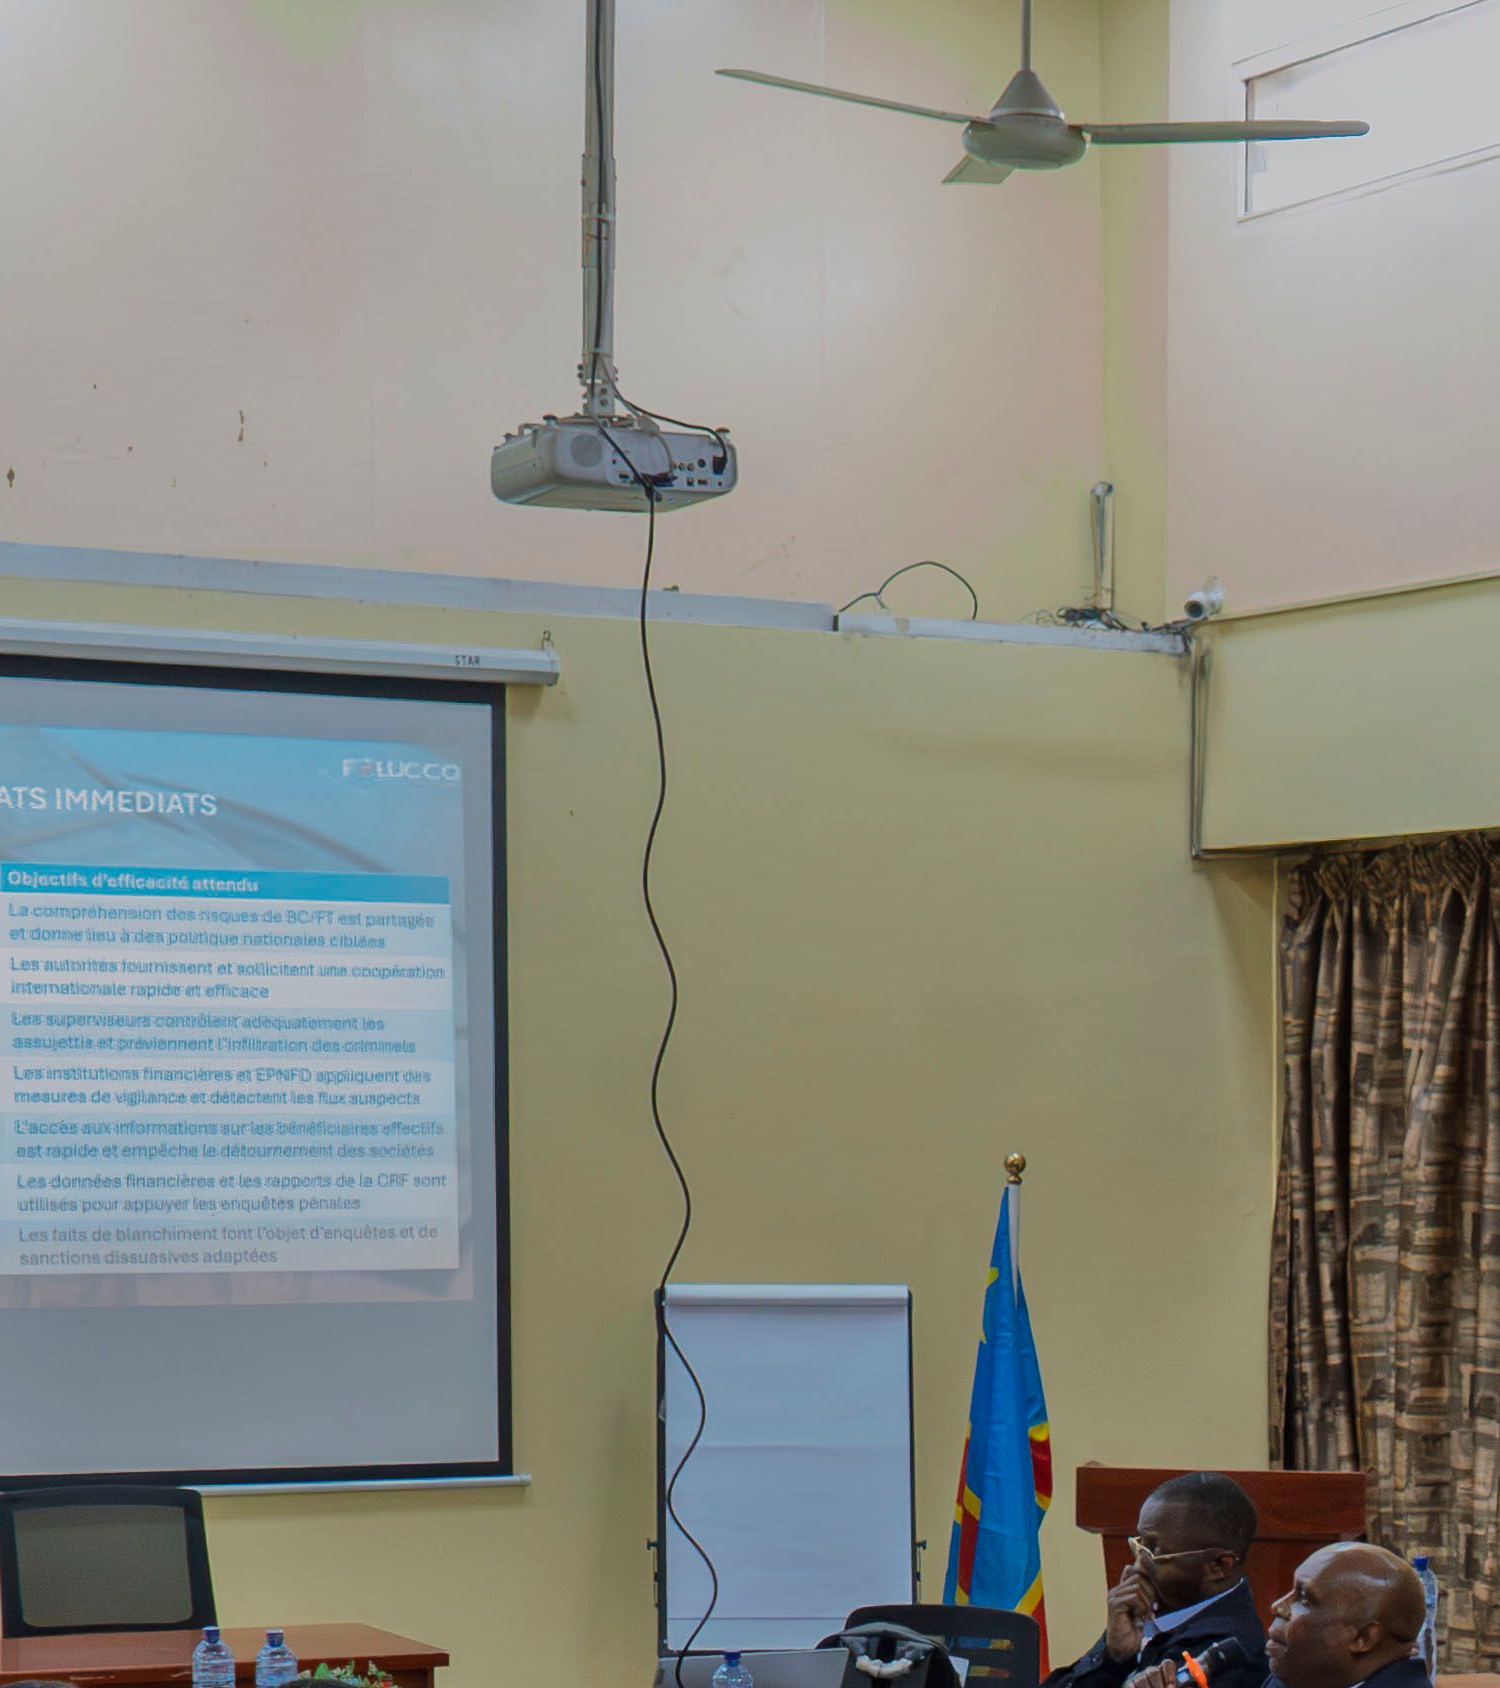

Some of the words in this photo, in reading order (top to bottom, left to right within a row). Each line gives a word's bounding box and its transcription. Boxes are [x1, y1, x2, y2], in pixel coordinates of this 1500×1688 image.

[454, 655, 481, 666] STAR
[56, 787, 218, 817] IMMEDIATS
[8, 873, 87, 889] Objectifs
[92, 875, 188, 888] d'efficacité
[193, 877, 259, 891] attendu
[9, 903, 28, 917] La
[33, 905, 162, 921] compréhension
[167, 907, 194, 920] des
[201, 908, 257, 924] risques
[262, 909, 282, 922] de
[287, 910, 333, 923] BC/FT
[338, 911, 361, 924] est
[10, 927, 25, 940] et
[31, 928, 82, 941] donne
[87, 929, 116, 942] lieu
[121, 929, 130, 942] à
[134, 930, 164, 943] des
[244, 933, 326, 946] nationales
[330, 934, 385, 948] ciblées
[11, 958, 39, 971] Les
[122, 960, 212, 974] fournissent
[218, 961, 233, 975] et
[238, 962, 314, 976] sollicitent
[11, 983, 125, 996] internationale
[131, 984, 180, 999] rapide
[185, 984, 200, 997] et
[205, 985, 268, 998] efficace
[11, 1013, 42, 1027] Les
[363, 1017, 384, 1031] les
[12, 1036, 92, 1052] assujettis
[98, 1036, 114, 1050] et
[119, 1037, 214, 1053] préviennent
[312, 1039, 339, 1052] des
[14, 1067, 42, 1080] Les
[47, 1067, 138, 1081] institutions
[143, 1068, 232, 1081] financières
[237, 1068, 251, 1081] et
[317, 1069, 400, 1084] appliquent
[404, 1069, 430, 1082] des
[15, 1092, 86, 1103] mesures
[91, 1090, 111, 1103] de
[116, 1090, 185, 1106] vigilance
[190, 1090, 205, 1103] et
[210, 1090, 286, 1104] détectent
[291, 1091, 313, 1104] les
[318, 1091, 345, 1104] flux
[82, 1124, 110, 1134] aux
[115, 1121, 216, 1134] informations
[221, 1124, 245, 1134] sur
[251, 1121, 273, 1134] les
[382, 1121, 444, 1134] effectifs
[17, 1144, 40, 1158] est
[46, 1144, 97, 1160] rapide
[102, 1144, 118, 1158] et
[123, 1144, 197, 1160] empêche
[203, 1144, 215, 1158] le
[221, 1144, 332, 1157] détournement
[338, 1144, 365, 1157] des
[17, 1175, 44, 1189] Les
[51, 1175, 121, 1188] données
[126, 1175, 214, 1188] financières
[219, 1174, 234, 1188] et
[239, 1174, 260, 1188] les
[265, 1174, 331, 1190] rapports
[335, 1174, 355, 1187] de
[360, 1174, 372, 1187] la
[377, 1174, 409, 1187] CRF
[414, 1173, 446, 1187] sont
[18, 1198, 76, 1212] utilisés
[82, 1201, 118, 1214] pour
[123, 1201, 189, 1214] appuyer
[194, 1198, 216, 1211] les
[220, 1198, 294, 1213] enquêtes
[299, 1197, 360, 1213] pénales
[20, 1228, 47, 1242] Les
[53, 1228, 86, 1241] faits
[92, 1228, 111, 1241] de
[116, 1227, 217, 1241] blanchiment
[221, 1227, 252, 1240] font
[257, 1226, 305, 1242] l'objet
[310, 1226, 395, 1242] d'enquêtes
[401, 1225, 414, 1239] et
[419, 1225, 437, 1239] de
[20, 1251, 99, 1264] sanctions
[104, 1250, 198, 1264] dissuasives
[203, 1250, 277, 1265] adaptées
